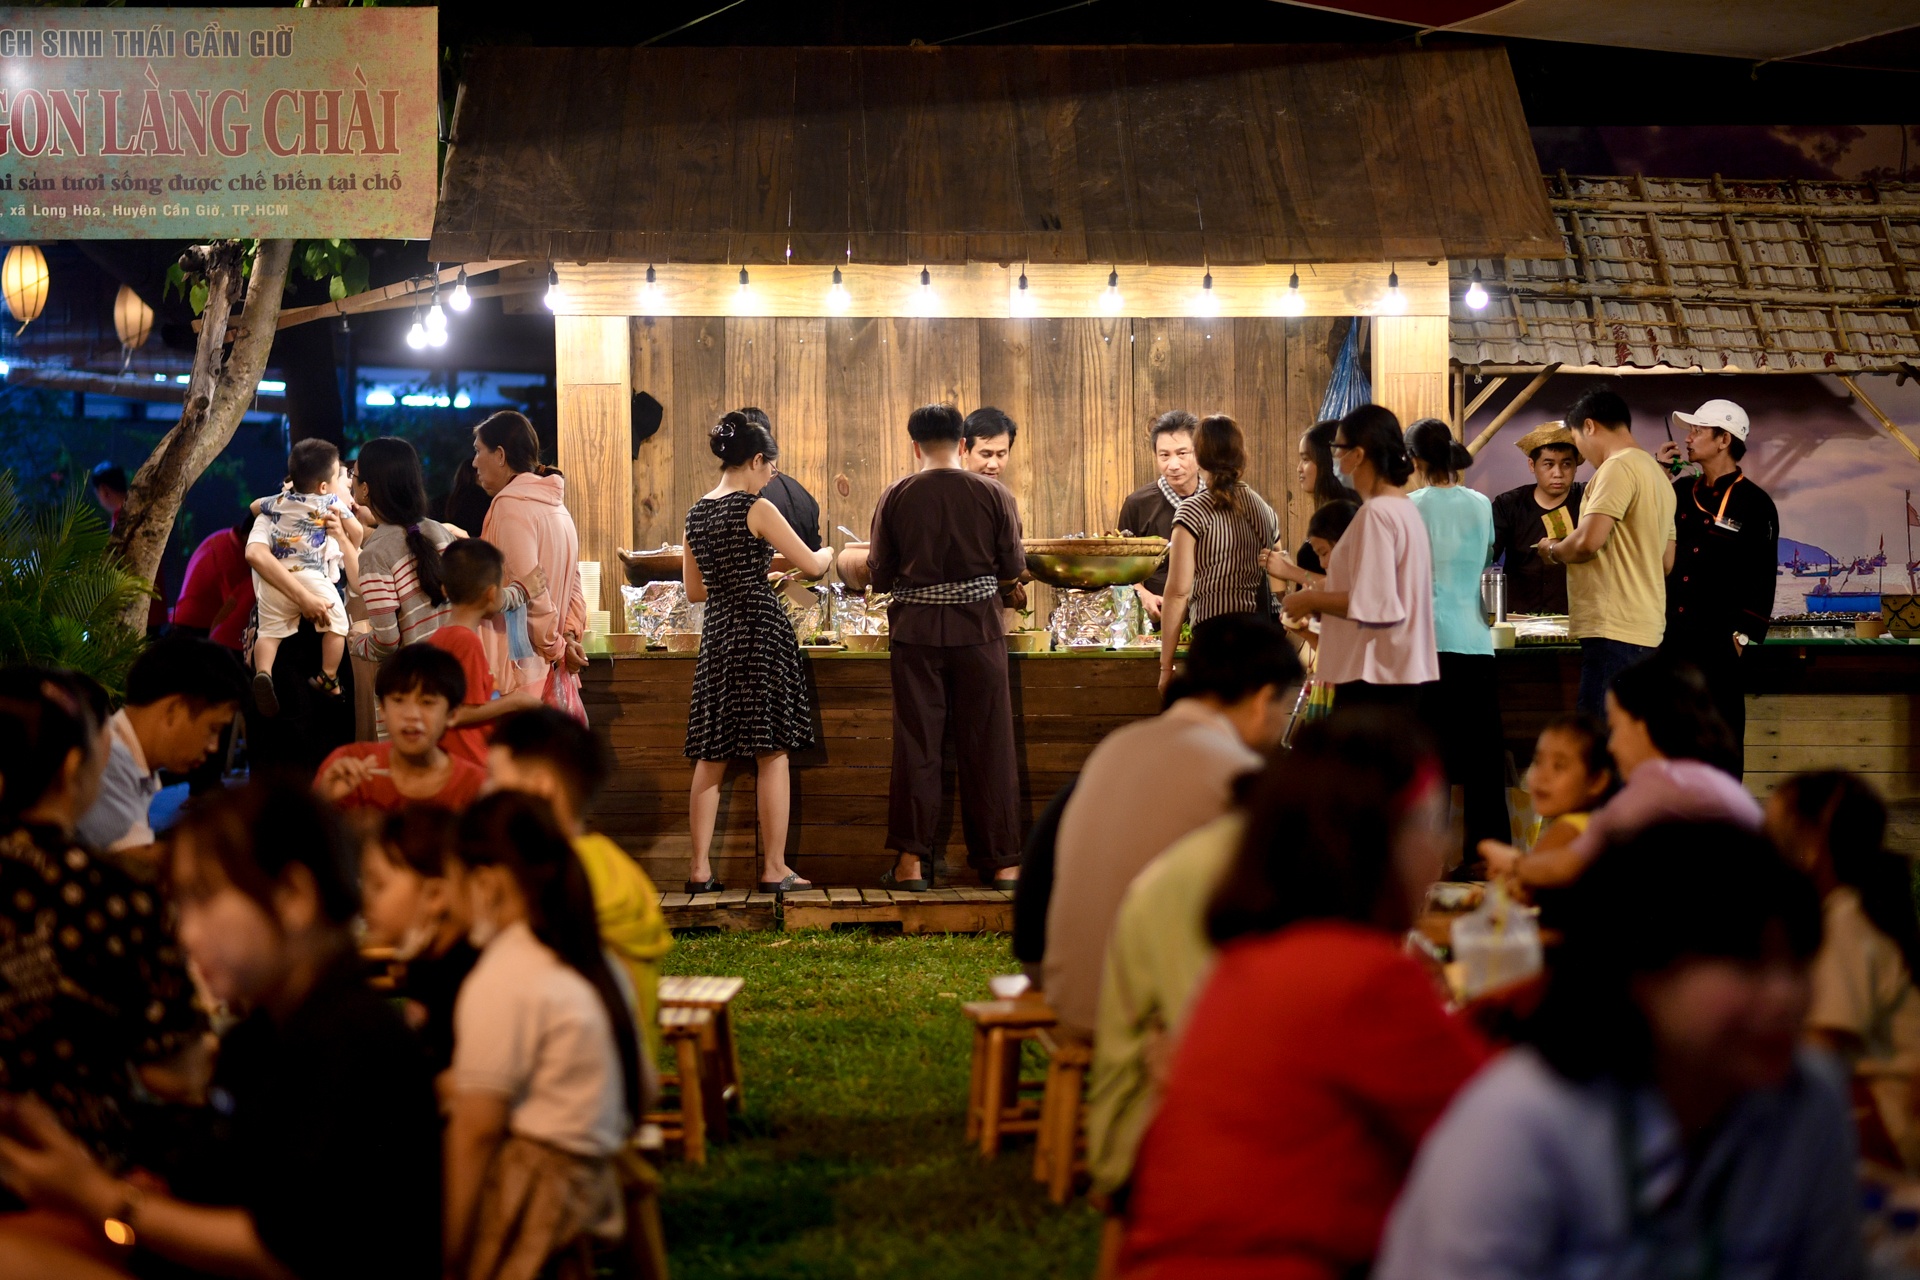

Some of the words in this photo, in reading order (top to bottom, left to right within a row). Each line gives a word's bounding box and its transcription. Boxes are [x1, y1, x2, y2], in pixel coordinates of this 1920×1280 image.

[42, 29, 103, 58] SINH
[113, 25, 175, 58] THÁI
[184, 22, 240, 58] CẦN
[249, 24, 294, 58] GIỜ
[0, 88, 89, 158] ON
[99, 63, 251, 158] LÀNG
[263, 63, 401, 158] CHÀI
[18, 171, 56, 191] sản
[62, 173, 106, 191] tươi
[111, 170, 163, 195] sống
[168, 173, 222, 194] được
[228, 170, 266, 191] chế
[273, 170, 322, 191] biến
[328, 173, 357, 194] tại
[362, 170, 402, 191] chỗ
[10, 204, 26, 216] xã
[33, 204, 67, 218] Long
[73, 204, 106, 218] Hòa,
[113, 204, 157, 218] Huyện
[163, 202, 190, 216] Cần
[196, 204, 225, 217] Giờ,
[231, 204, 289, 216] TP.HCM
